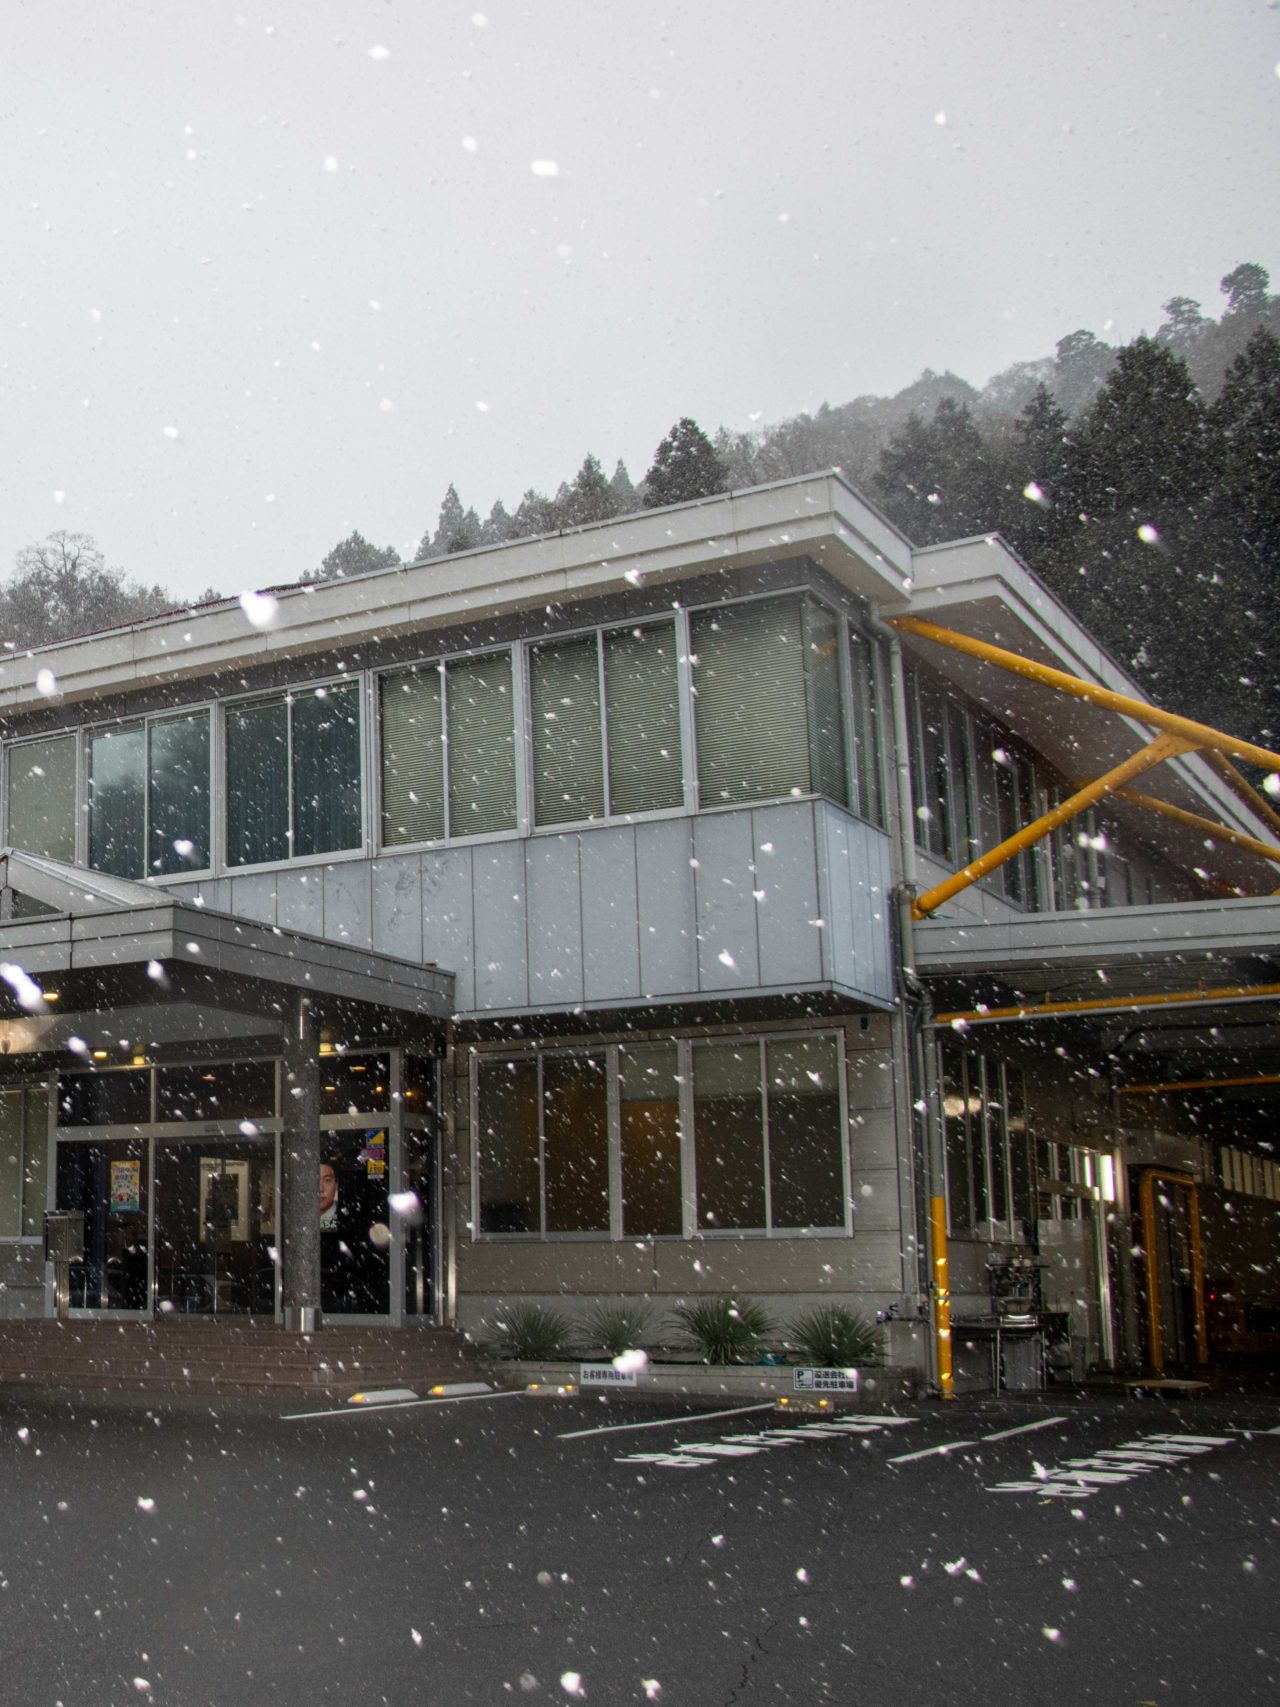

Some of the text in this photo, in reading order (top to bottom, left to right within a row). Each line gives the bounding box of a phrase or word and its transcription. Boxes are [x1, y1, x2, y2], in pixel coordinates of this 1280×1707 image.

[797, 1370, 804, 1379] P
[814, 1370, 855, 1379] 運送会社
[814, 1380, 855, 1389] 優先駐車場
